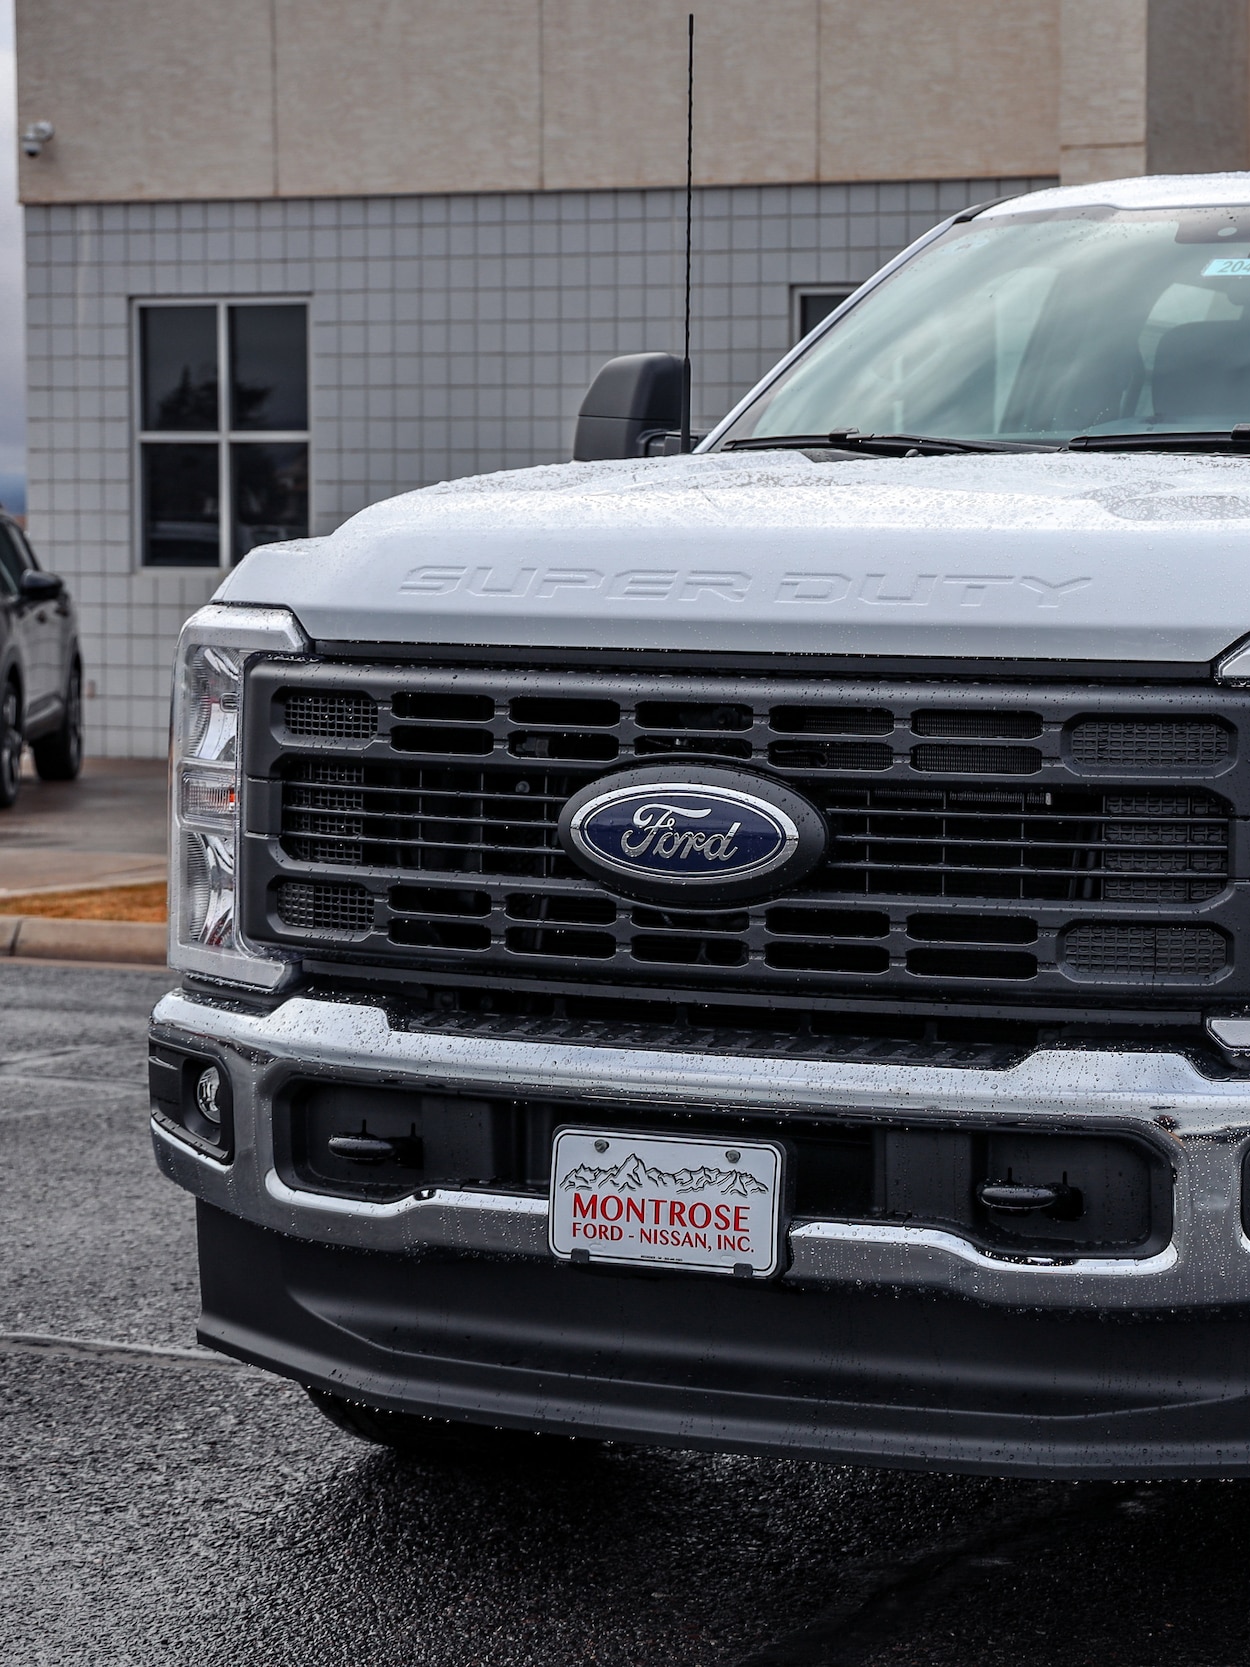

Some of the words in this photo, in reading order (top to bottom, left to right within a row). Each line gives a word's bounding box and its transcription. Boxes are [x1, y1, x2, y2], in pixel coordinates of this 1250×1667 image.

[397, 564, 754, 603] SUPER
[774, 571, 1093, 608] DUTY
[620, 802, 743, 862] Ford
[573, 1192, 751, 1233] MONTROSE
[572, 1222, 624, 1241] FORD
[640, 1228, 713, 1252] NISSAN,
[717, 1234, 755, 1253] INC.
